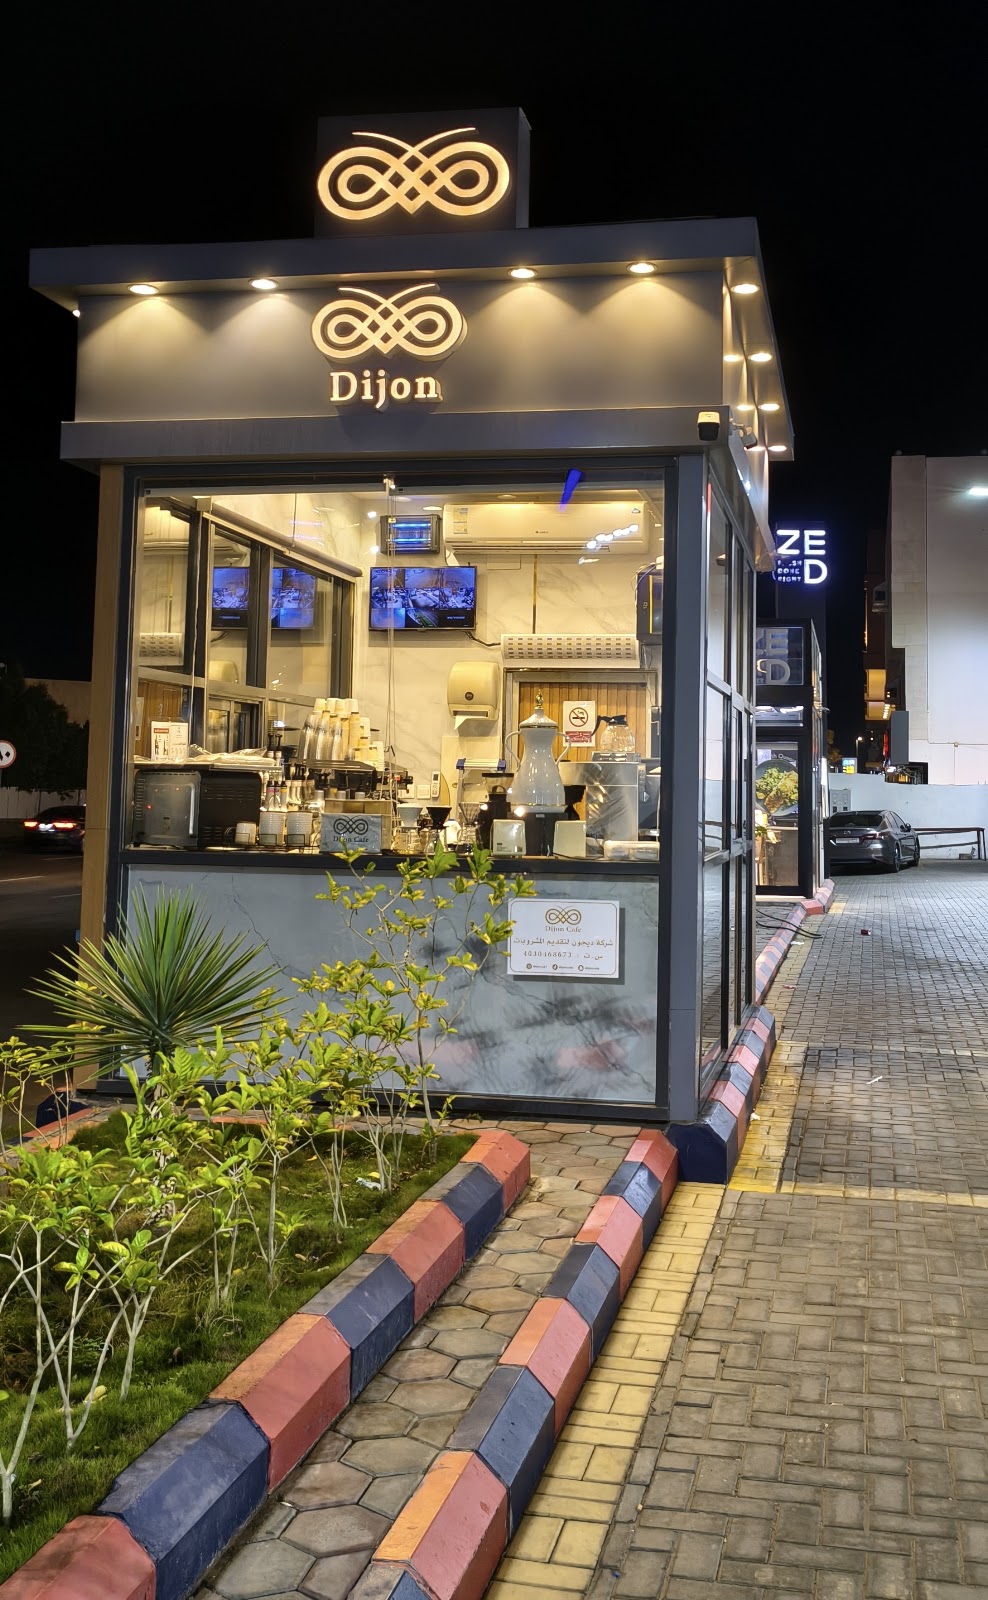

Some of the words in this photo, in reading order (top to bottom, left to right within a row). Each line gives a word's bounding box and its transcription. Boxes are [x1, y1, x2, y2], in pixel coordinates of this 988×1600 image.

[329, 369, 439, 409] Dijon
[776, 529, 826, 555] ZE
[804, 558, 828, 584] D
[333, 835, 352, 843] Dion
[545, 925, 565, 933] Dijon
